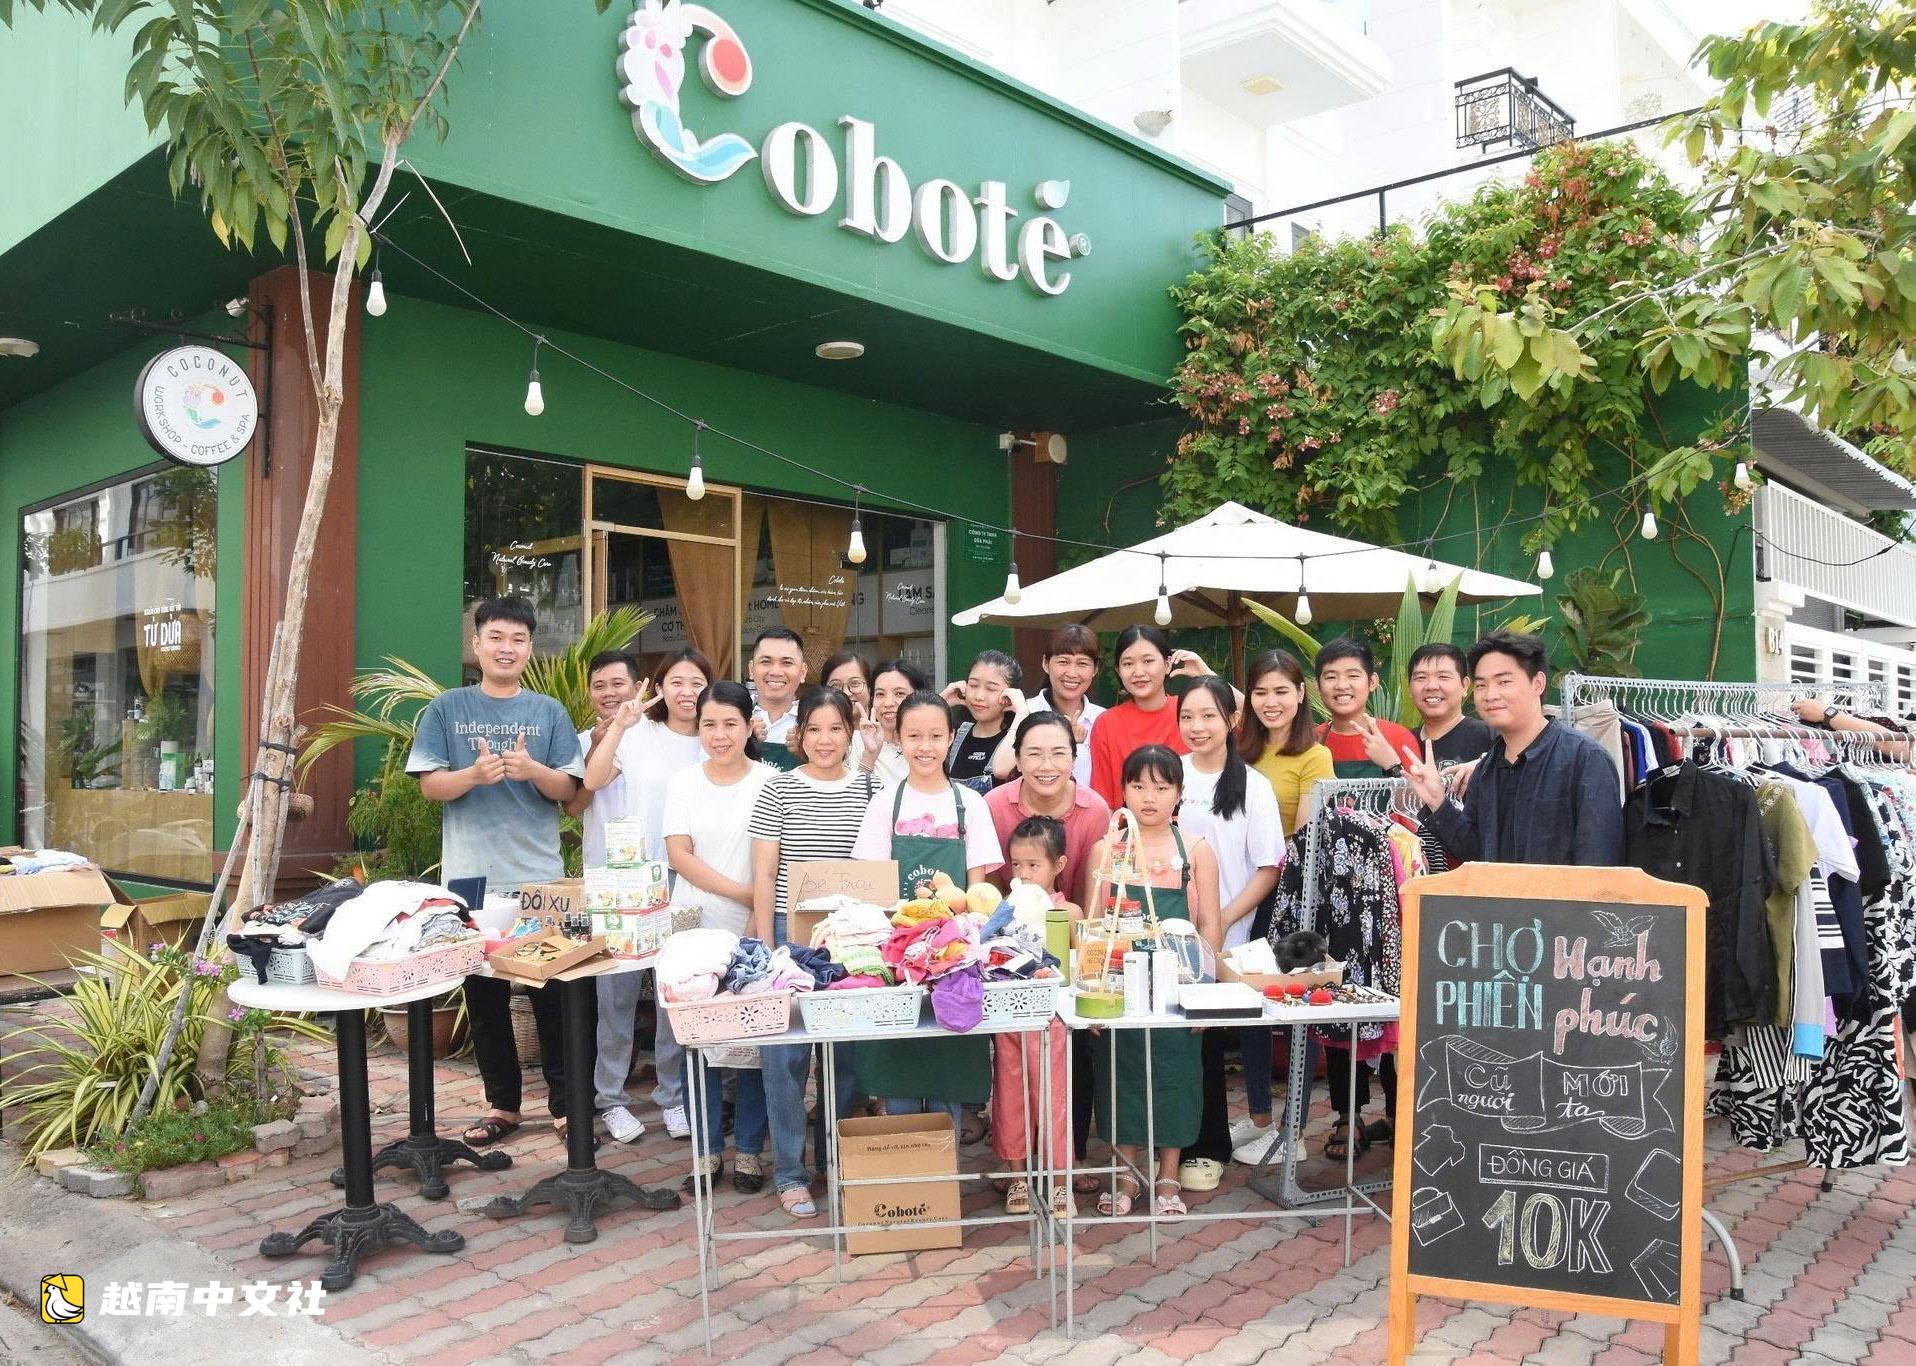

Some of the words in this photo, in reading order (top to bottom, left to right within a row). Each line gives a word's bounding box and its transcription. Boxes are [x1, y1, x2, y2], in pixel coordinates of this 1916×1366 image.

[167, 356, 248, 397] COCONUT
[154, 386, 182, 444] WORKSHOP
[191, 440, 232, 455] COFFEE
[230, 434, 240, 445] &
[237, 414, 250, 435] SPA
[454, 720, 541, 737] Independent
[468, 737, 526, 751] Tough
[548, 895, 571, 912] XU
[1438, 918, 1545, 983] CHỢ
[1553, 929, 1663, 987] Hạnh
[1436, 969, 1543, 1031] PHIÊN
[1553, 987, 1659, 1056] phúc
[1464, 1063, 1512, 1092] Cũ
[1563, 1069, 1629, 1097] MỚI
[1457, 1091, 1515, 1112] người
[1555, 1096, 1605, 1119] ta
[1487, 1148, 1552, 1178] ĐỒNG
[1558, 1155, 1596, 1183] GIÁ
[874, 1203, 927, 1218] Coboté
[1482, 1189, 1614, 1274] 10K
